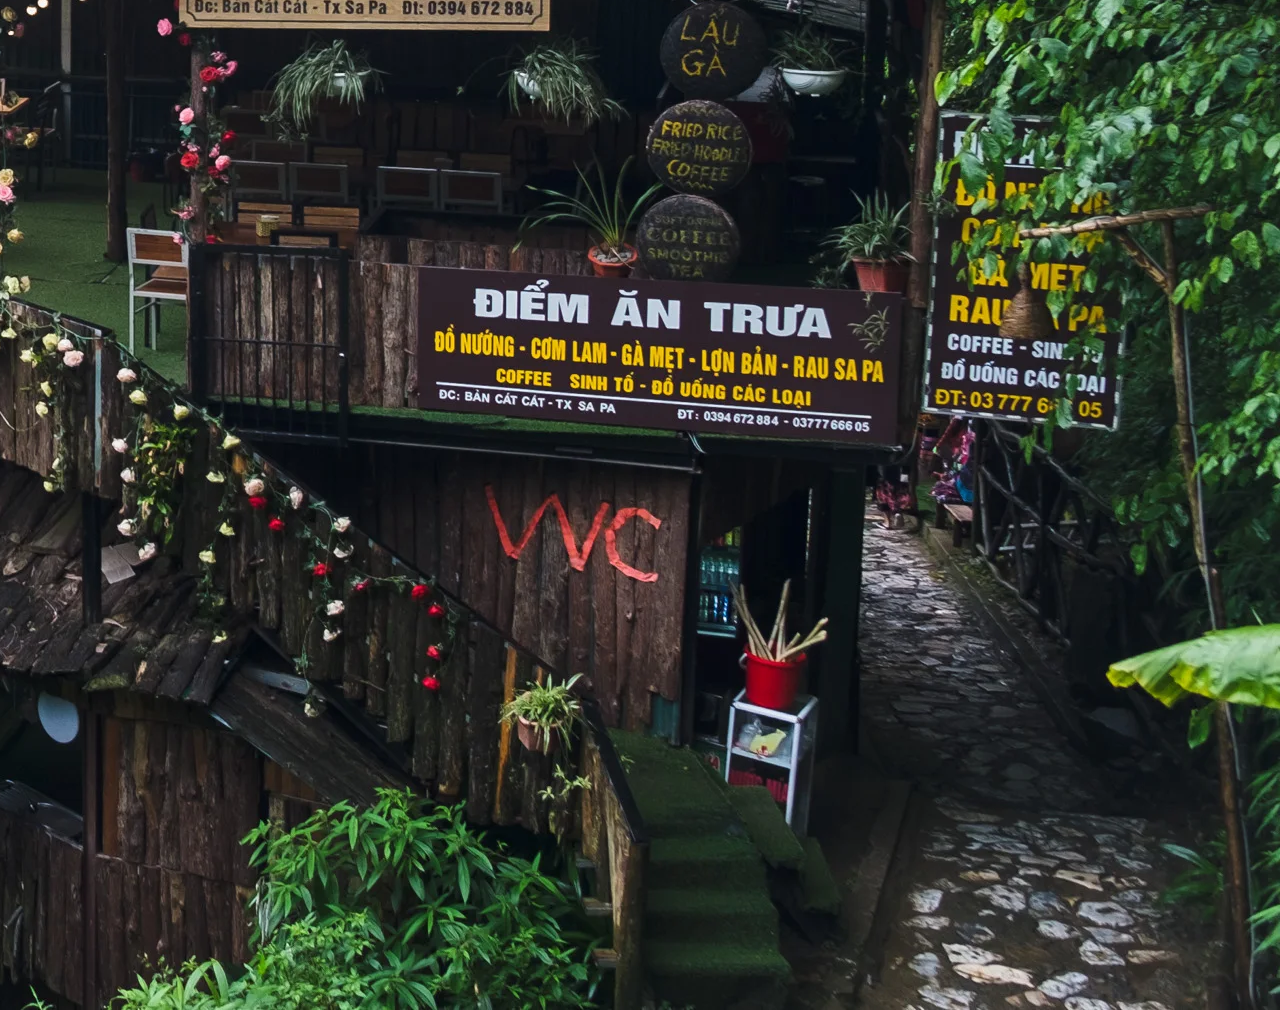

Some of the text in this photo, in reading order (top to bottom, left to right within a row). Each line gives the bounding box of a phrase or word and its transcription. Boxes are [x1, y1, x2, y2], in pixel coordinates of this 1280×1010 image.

[194, 0, 218, 14] Đc:
[283, 0, 308, 14] Cát
[323, 0, 340, 15] Tx
[345, 0, 364, 15] Sa
[369, 0, 388, 15] Pa
[427, 0, 466, 16] 0394
[471, 1, 500, 16] 672
[504, 1, 535, 16] 884
[666, 160, 730, 182] COFFEE
[646, 227, 731, 246] COFFEE
[473, 279, 832, 339] ĐIỂM ĂN TRƯA
[434, 324, 455, 353] ĐỒ
[460, 329, 515, 358] NƯỚNG
[531, 337, 566, 361] CƠM
[572, 340, 607, 364] LAM
[621, 340, 644, 367] GÀ
[649, 345, 684, 373] MẸT
[701, 348, 735, 377] LỢN
[741, 345, 777, 376] BẢN
[793, 355, 829, 379] RAU
[834, 358, 858, 381] SA
[862, 359, 884, 383] PA
[947, 333, 1013, 356] COFFEE
[940, 358, 967, 380] ĐỒ
[969, 360, 1018, 386] UỐNG
[1024, 367, 1060, 389] CÁC
[439, 389, 460, 401] ĐC:
[495, 393, 517, 405] CÁT
[521, 395, 545, 408] CÁT
[555, 399, 572, 410] TX
[578, 401, 595, 412] SA
[600, 403, 616, 414] PA
[496, 368, 552, 387] COFFEE
[570, 373, 608, 391] SINH
[613, 371, 634, 393] TỐ
[651, 375, 674, 396] ĐỒ
[680, 377, 726, 400] UỐNG
[732, 383, 766, 402] CÁC
[772, 388, 812, 409] LOẠI
[935, 388, 967, 405] ĐT:
[970, 391, 994, 409] 03
[997, 393, 1032, 412] 777
[1078, 401, 1102, 418] 05
[677, 409, 699, 421] ĐT:
[703, 410, 732, 423] 0394
[733, 414, 755, 425] 672
[756, 415, 779, 426] 884
[485, 483, 662, 583] WC
